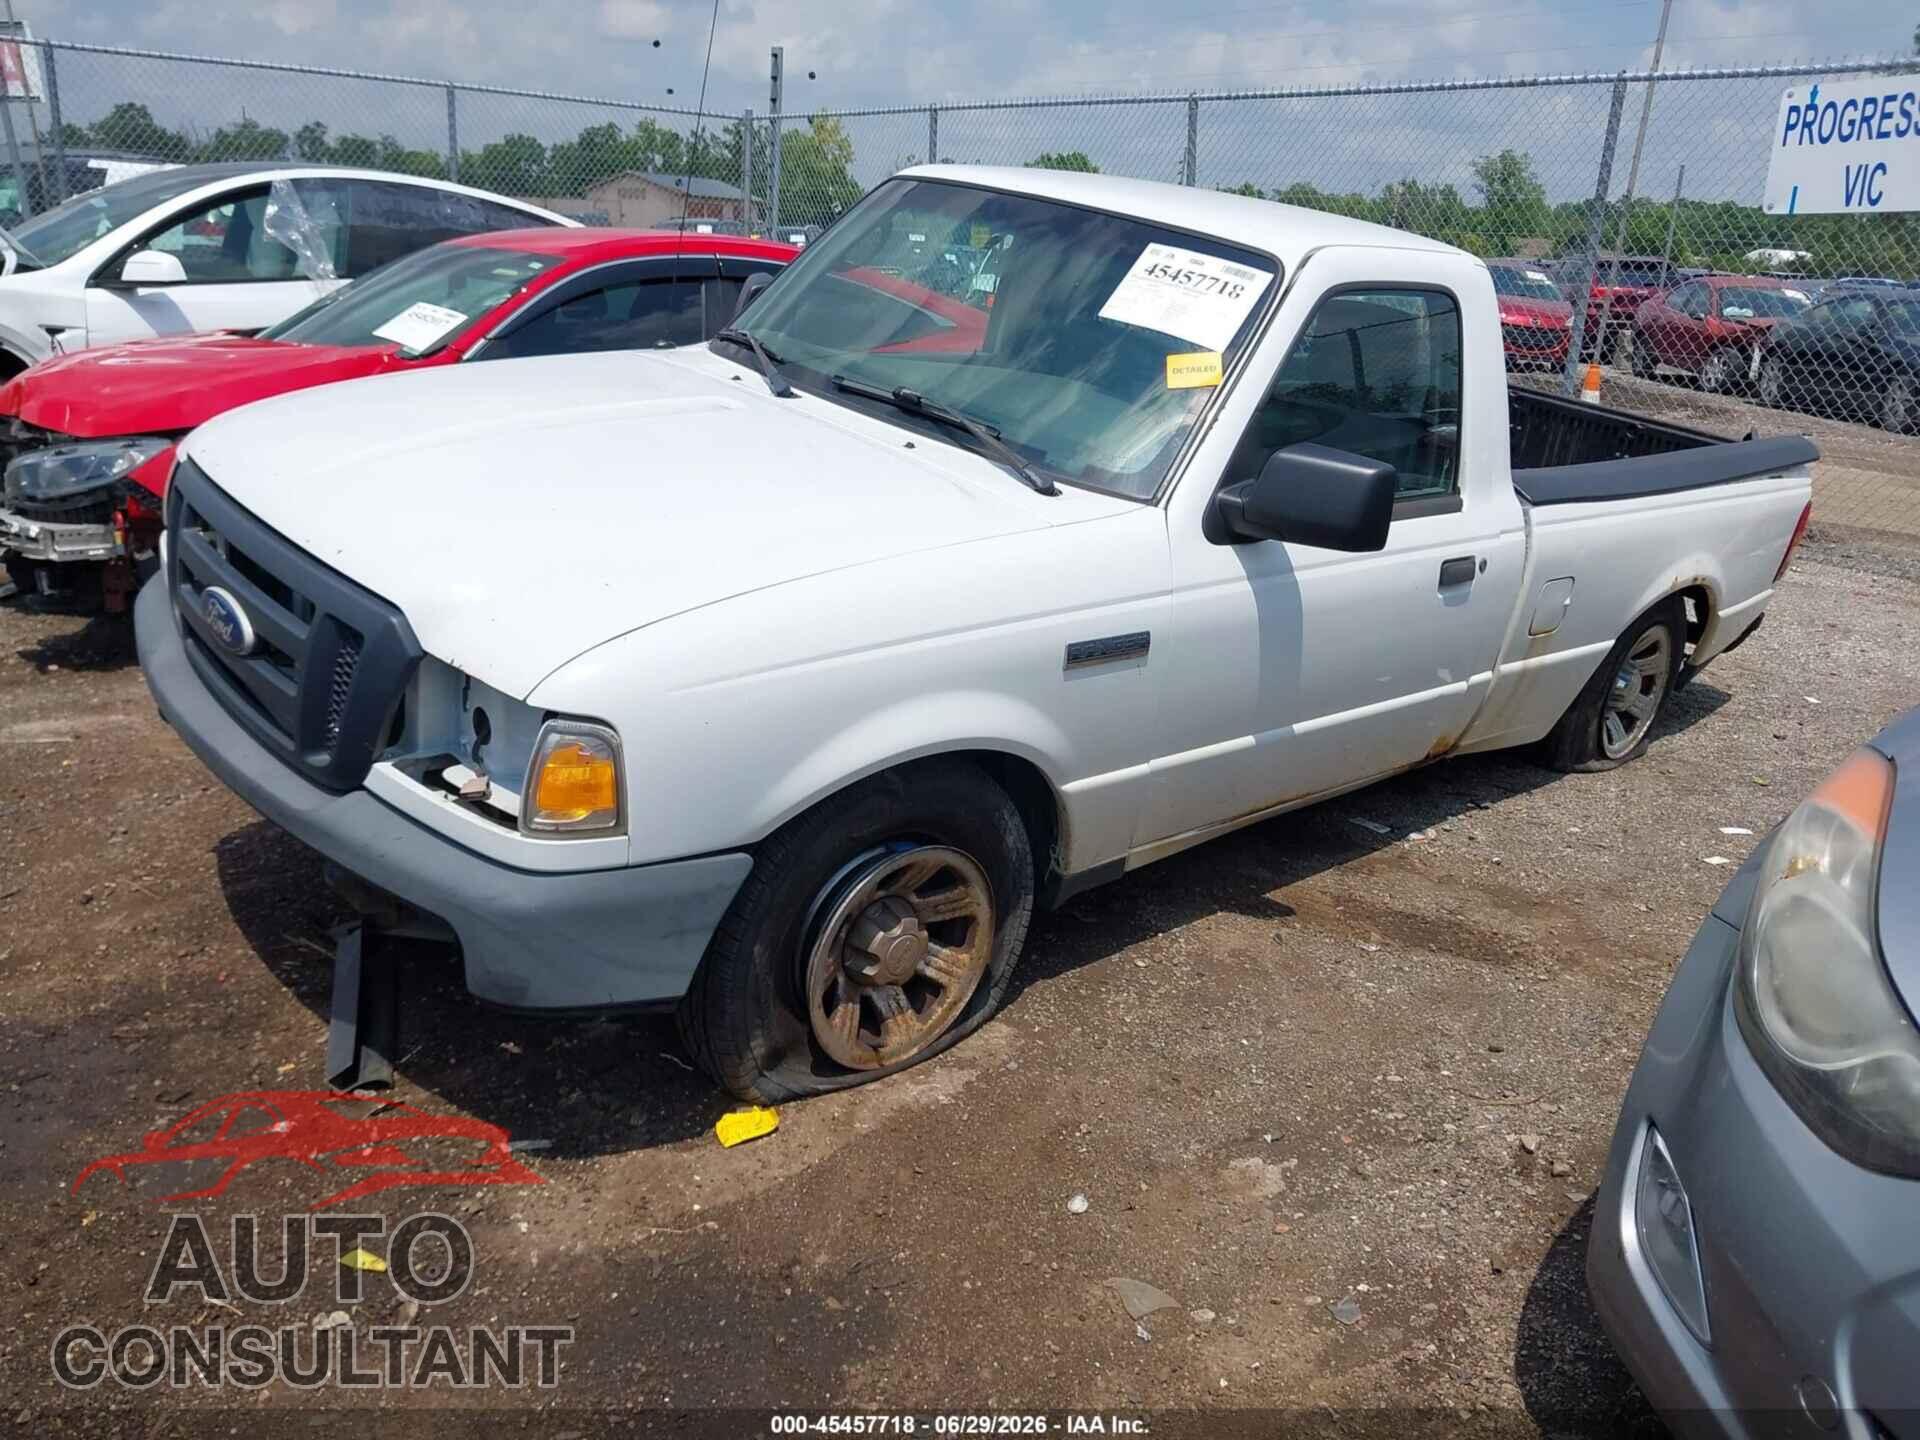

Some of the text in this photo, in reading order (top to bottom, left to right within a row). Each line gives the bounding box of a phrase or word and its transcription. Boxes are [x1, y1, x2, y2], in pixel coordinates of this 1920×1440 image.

[1845, 162, 1887, 207] VIC
[1144, 262, 1246, 300] 45457718
[1172, 365, 1217, 375] DETAILED
